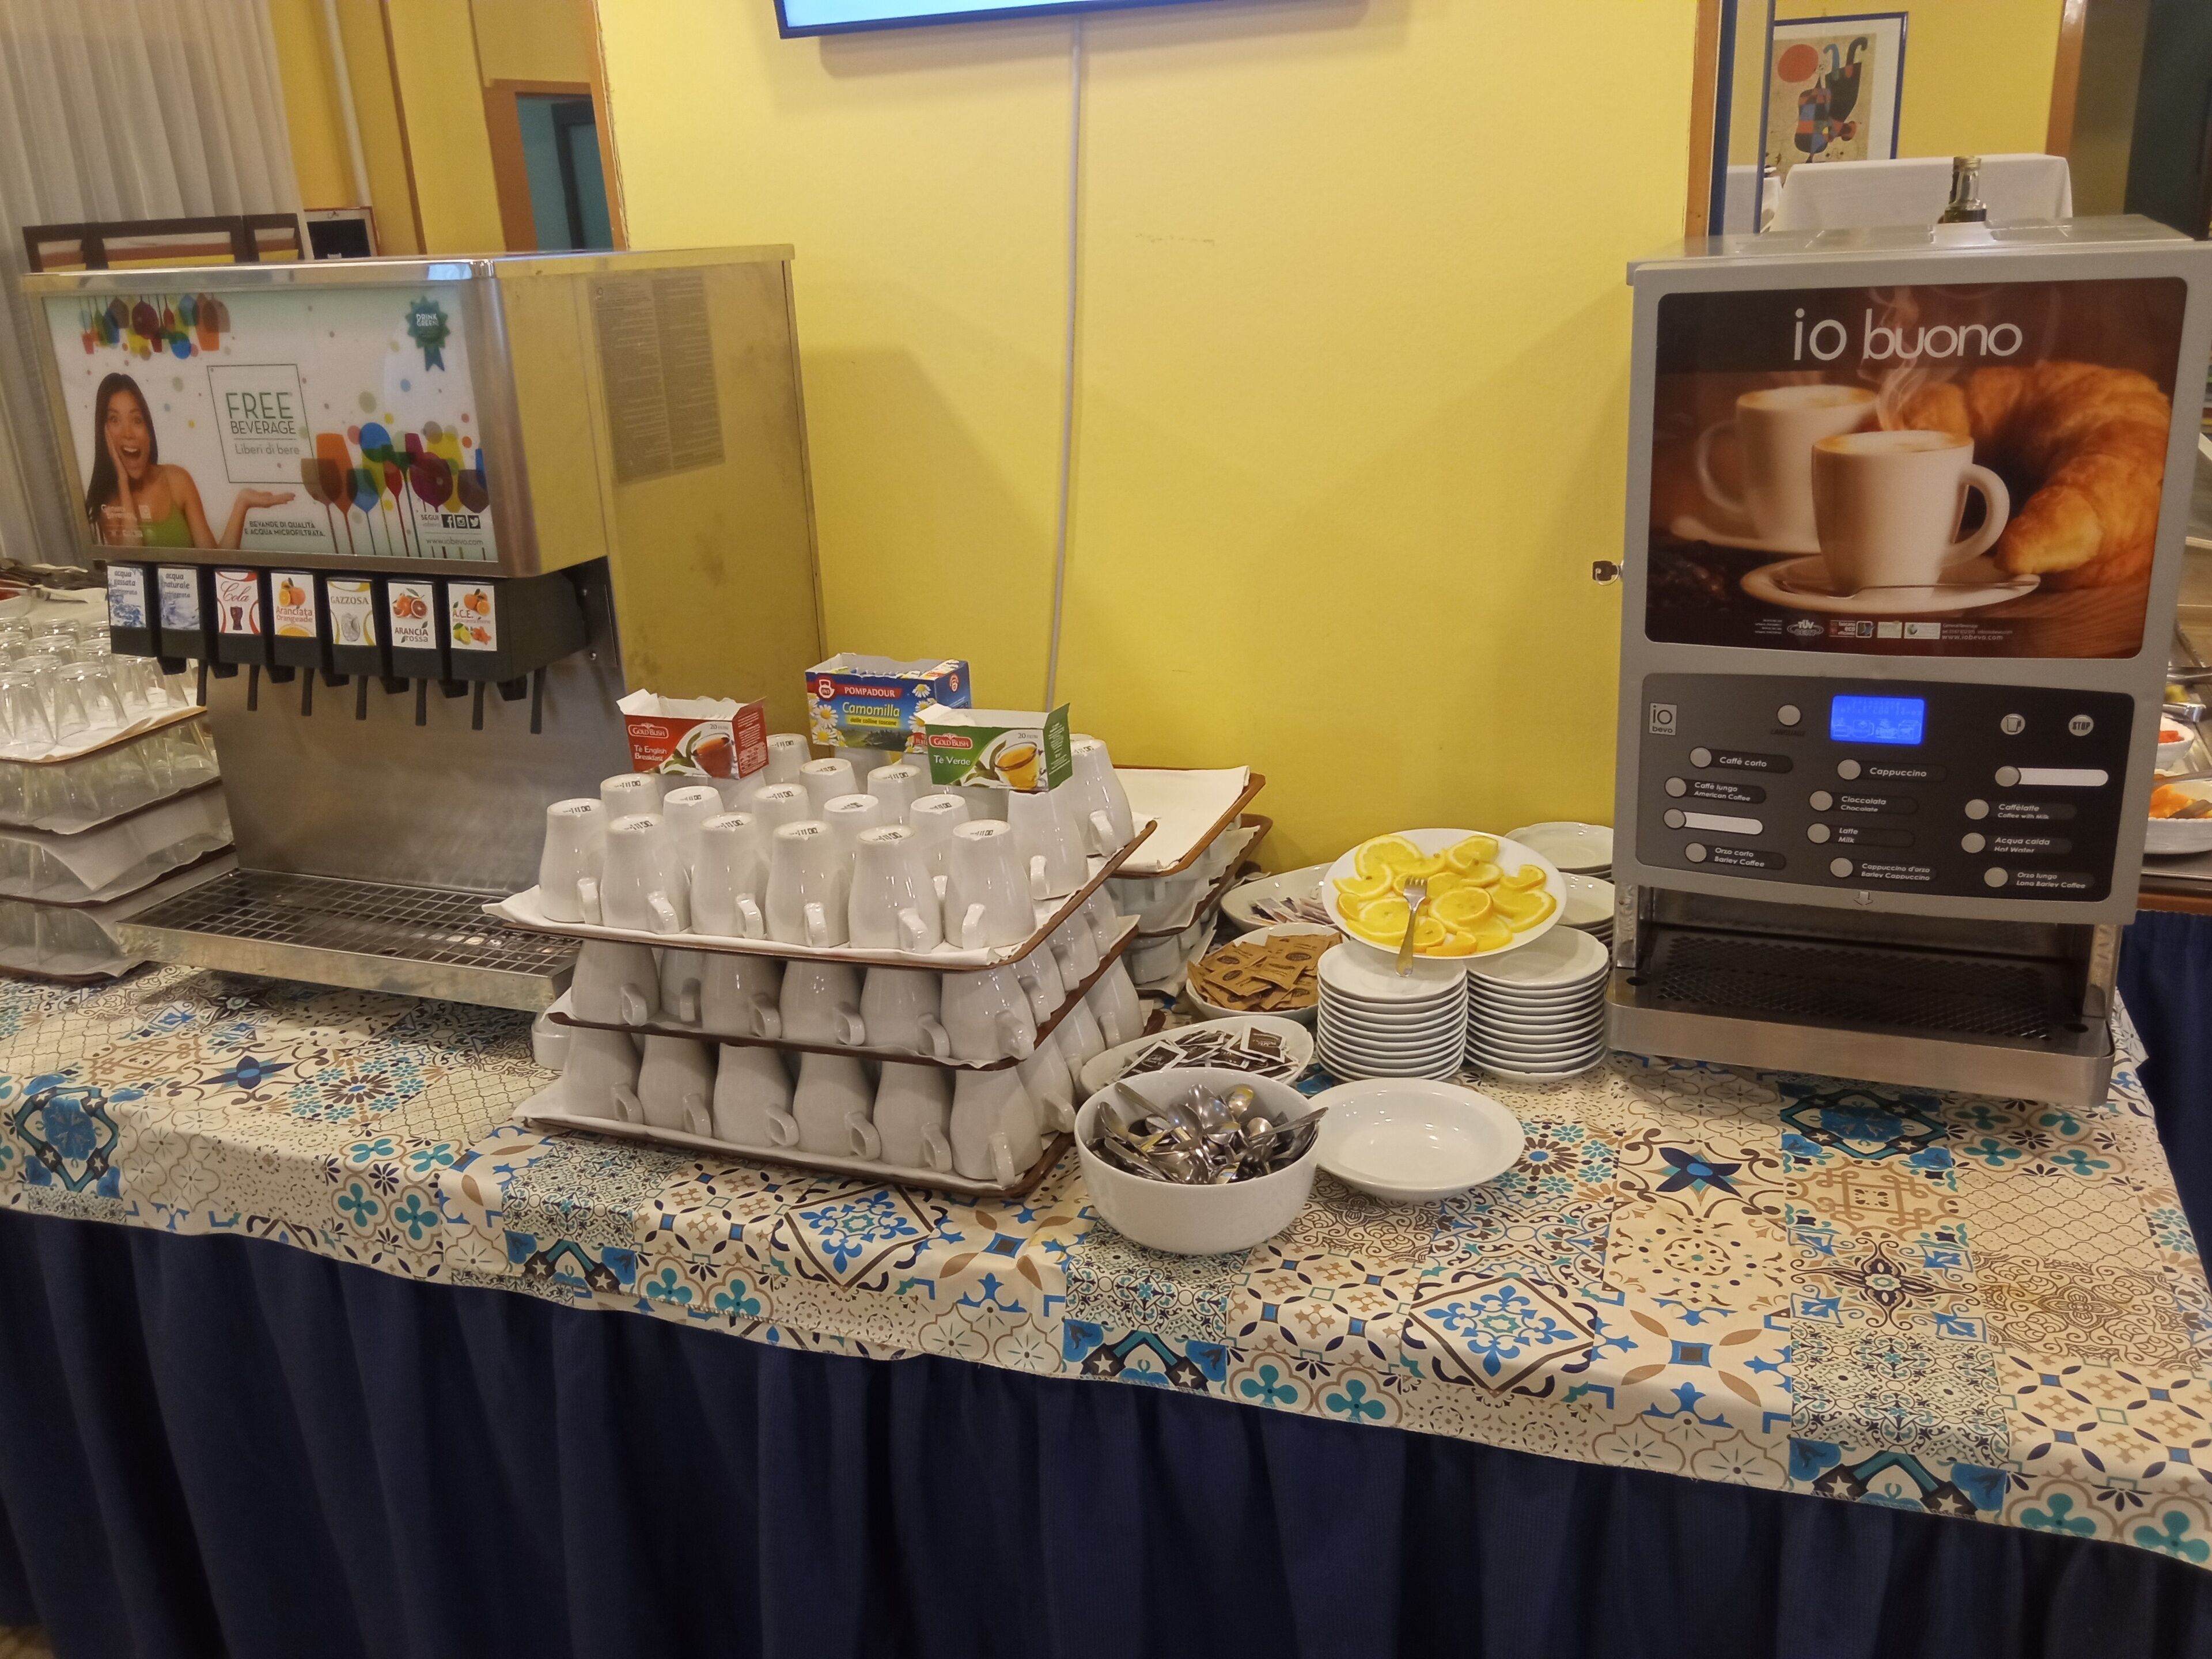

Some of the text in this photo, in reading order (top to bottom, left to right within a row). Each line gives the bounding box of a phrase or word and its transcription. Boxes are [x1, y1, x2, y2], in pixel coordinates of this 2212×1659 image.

[1794, 308, 2024, 361] io buono
[225, 392, 294, 419] FREE
[230, 421, 297, 434] BEVERAGE
[234, 444, 300, 455] Liberi di bere
[249, 520, 279, 528] BEVANDE
[426, 536, 484, 546] www.iobevo.com
[114, 570, 132, 578] acqua
[165, 573, 184, 581] acqua
[221, 581, 252, 603] Cola
[331, 596, 369, 605] GAZZOSA
[276, 606, 313, 617] Aranciata
[276, 615, 313, 623] Orangeade
[1797, 619, 1815, 629] TÜV
[395, 626, 429, 637] ARANCIA
[844, 687, 896, 698] POMPADOUR
[842, 702, 901, 718] Camomilla
[1652, 704, 1673, 725] io
[1652, 725, 1673, 734] bevo
[2072, 721, 2091, 731] STOP
[632, 728, 666, 737] GOLD BUSH
[933, 738, 969, 747] GOLD BUSH
[644, 746, 667, 755] English
[634, 753, 664, 762] Breakfast
[945, 755, 971, 766] Verde
[1719, 756, 1767, 768] Caffè corto
[1869, 767, 1927, 777] Cappuccino
[1694, 781, 1738, 793] Caffè lungo
[1694, 790, 1751, 802] American Coffee
[1841, 796, 1887, 805] Cioccolata
[1840, 804, 1879, 813] Chocolate
[1998, 803, 2040, 812] Caffèlatte
[1839, 827, 1859, 835] Latte
[1838, 836, 1855, 844] Milk
[1995, 837, 2024, 846] Acqua
[1733, 850, 1755, 858] corto
[1714, 856, 1765, 867] Barley Coffee
[1861, 862, 1907, 872] Cappuccino
[1861, 870, 1930, 881] Barley Cappuccino
[2036, 872, 2058, 881] lungo
[2035, 880, 2059, 888] Barley
[2061, 881, 2086, 889] Coffee
